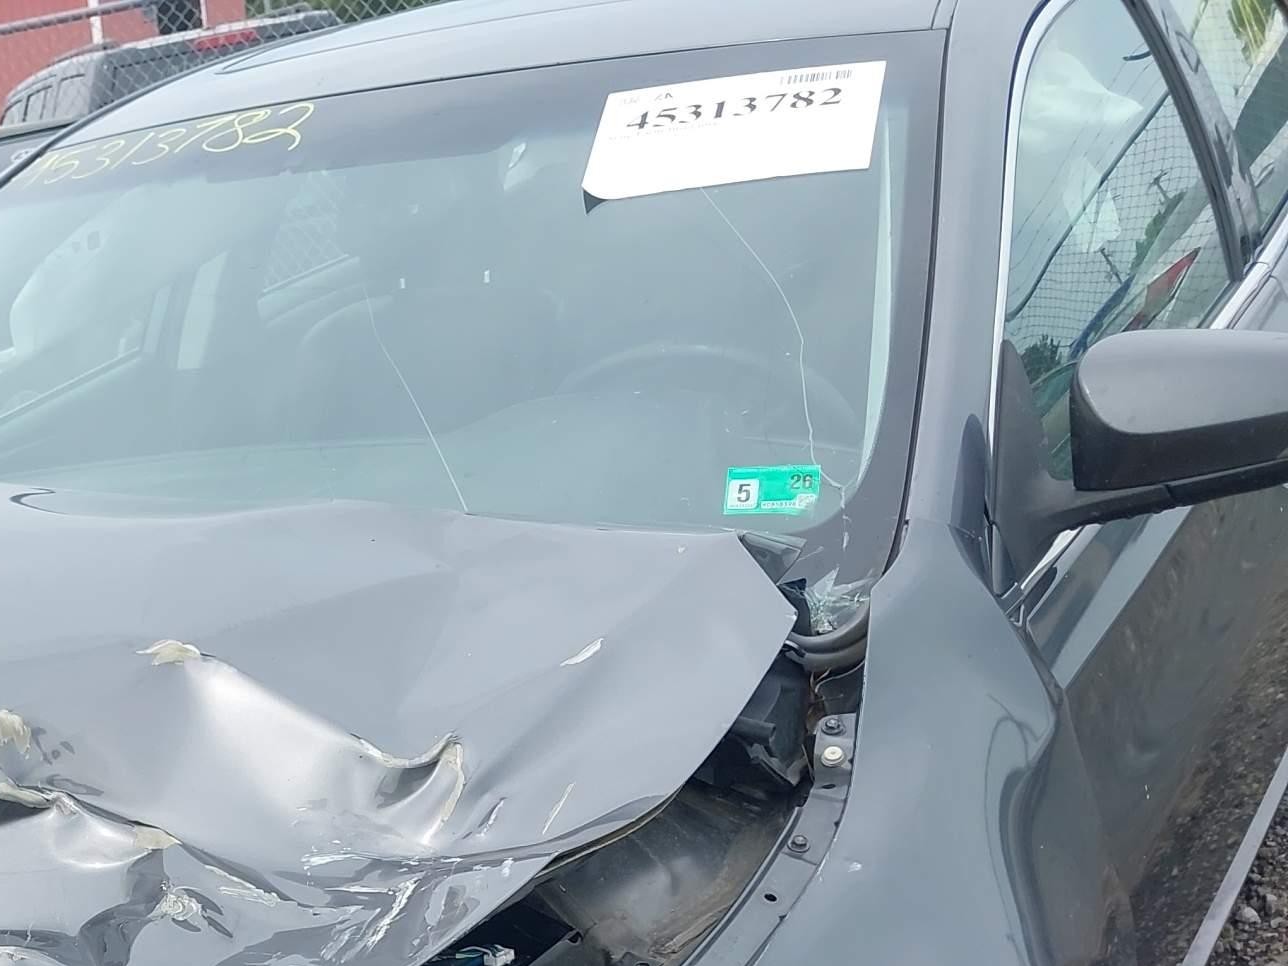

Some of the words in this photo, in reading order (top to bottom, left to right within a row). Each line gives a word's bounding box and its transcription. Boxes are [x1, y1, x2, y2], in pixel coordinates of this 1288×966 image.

[625, 86, 843, 130] 45313782
[790, 473, 814, 490] 26
[736, 483, 752, 503] 5
